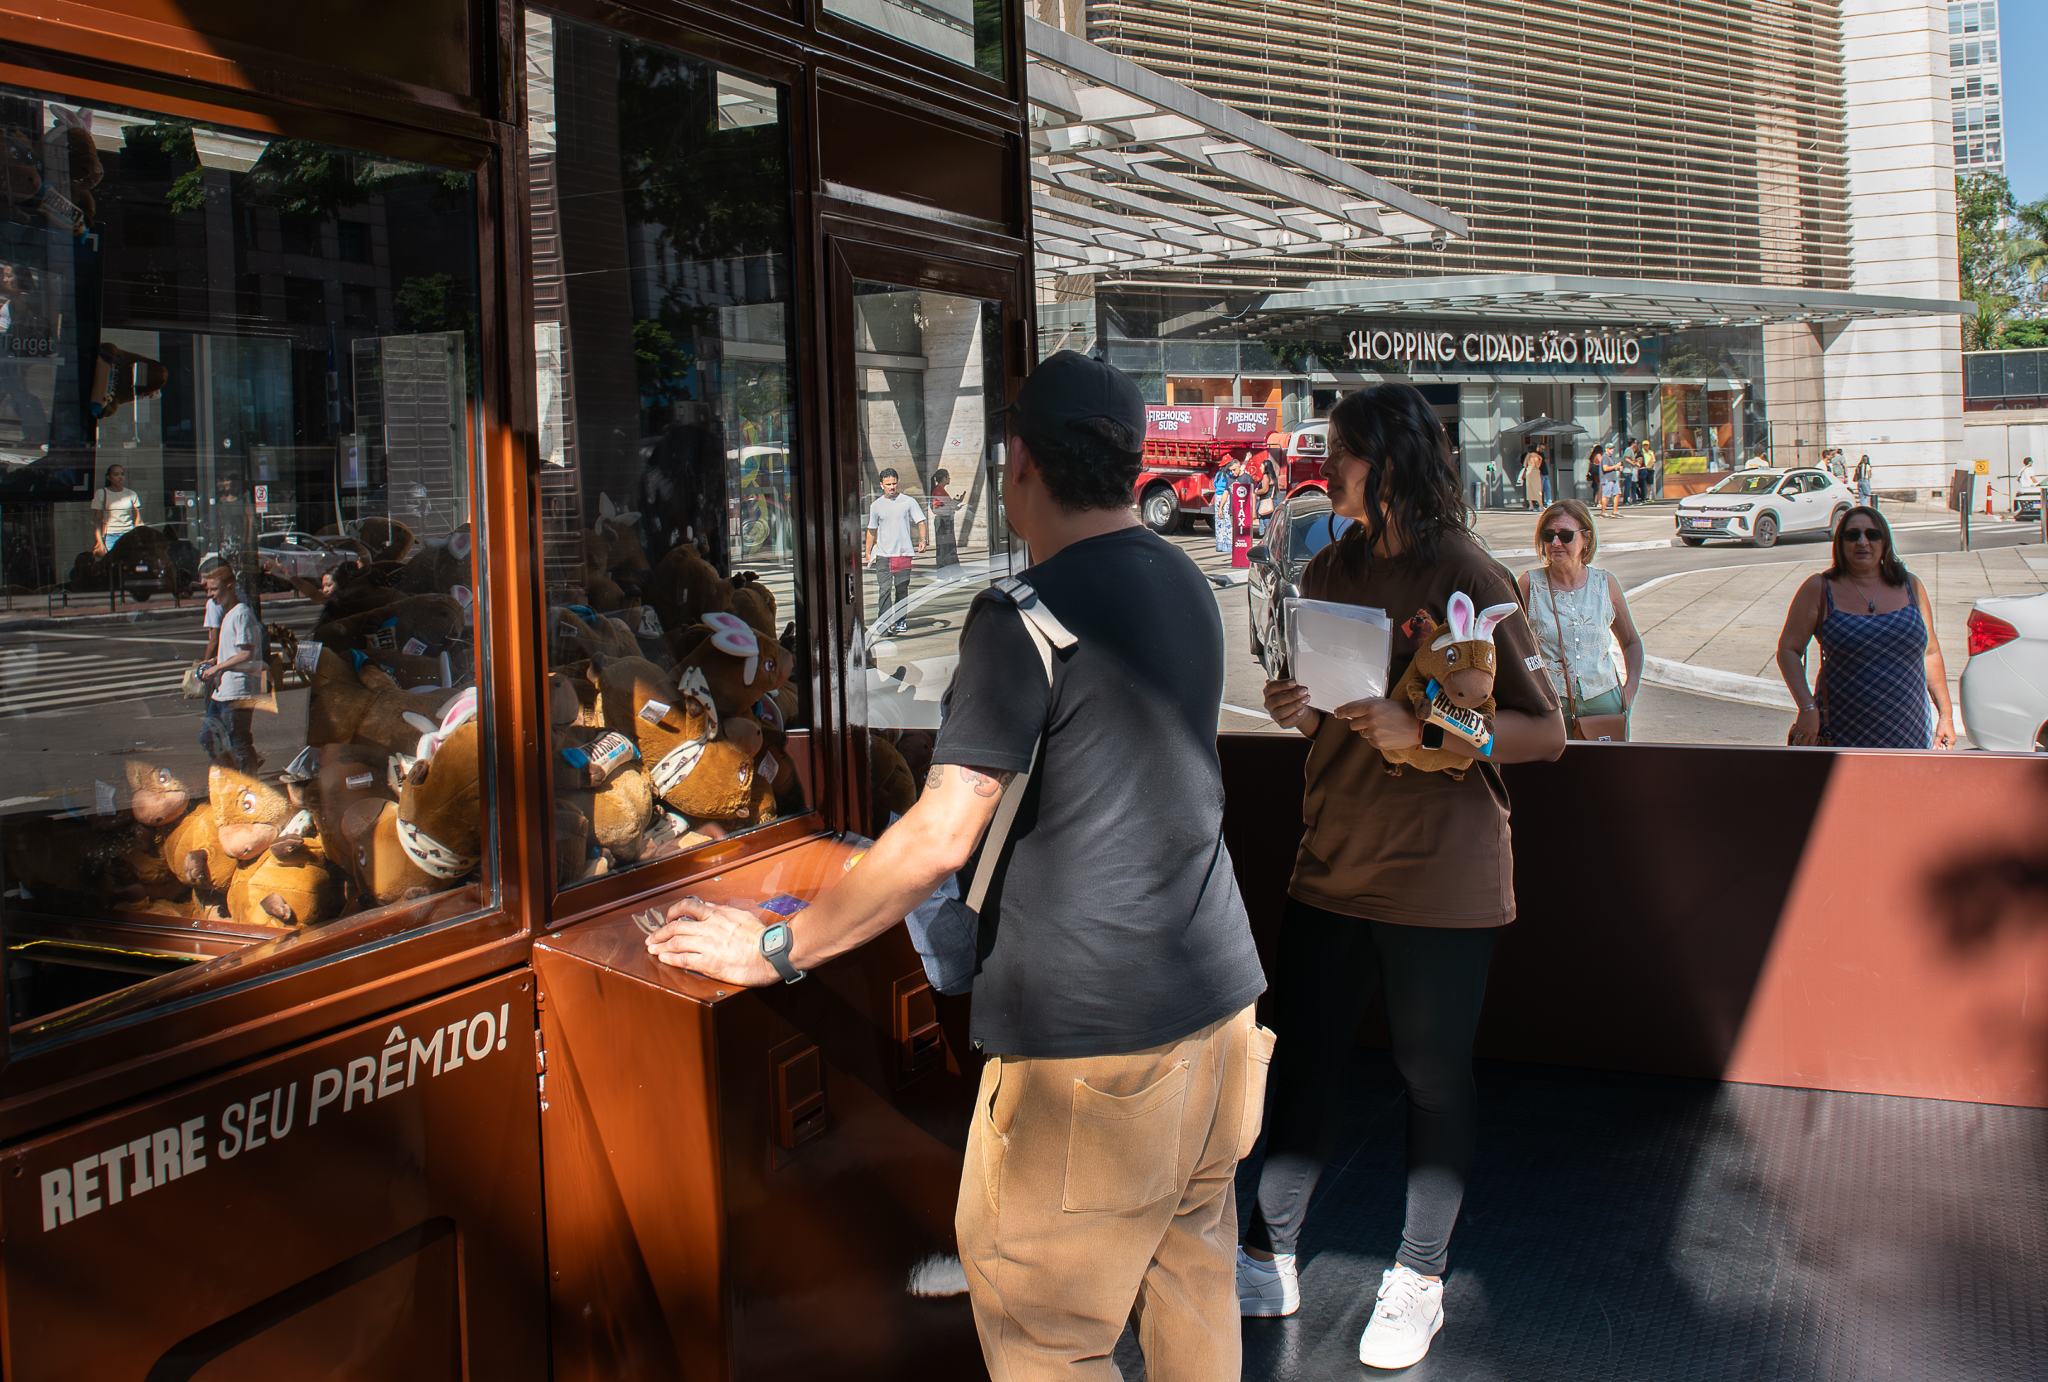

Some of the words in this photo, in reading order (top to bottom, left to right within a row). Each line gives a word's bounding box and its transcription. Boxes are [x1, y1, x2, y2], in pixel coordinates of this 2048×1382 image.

[1, 333, 54, 355] Target
[1348, 331, 1456, 361] SHOPPING
[1463, 334, 1535, 362] CIDADE
[1541, 330, 1578, 364] SÃO
[1585, 337, 1640, 364] PAULO
[1148, 410, 1190, 423] FIREHOUSE
[1227, 412, 1267, 426] FIREHOUSE
[1158, 421, 1178, 431] SUBS
[1237, 422, 1256, 433] SUBS
[40, 1115, 206, 1232] RETIRE
[218, 1082, 297, 1160] SEU
[308, 1003, 510, 1126] PRÊMIO!
